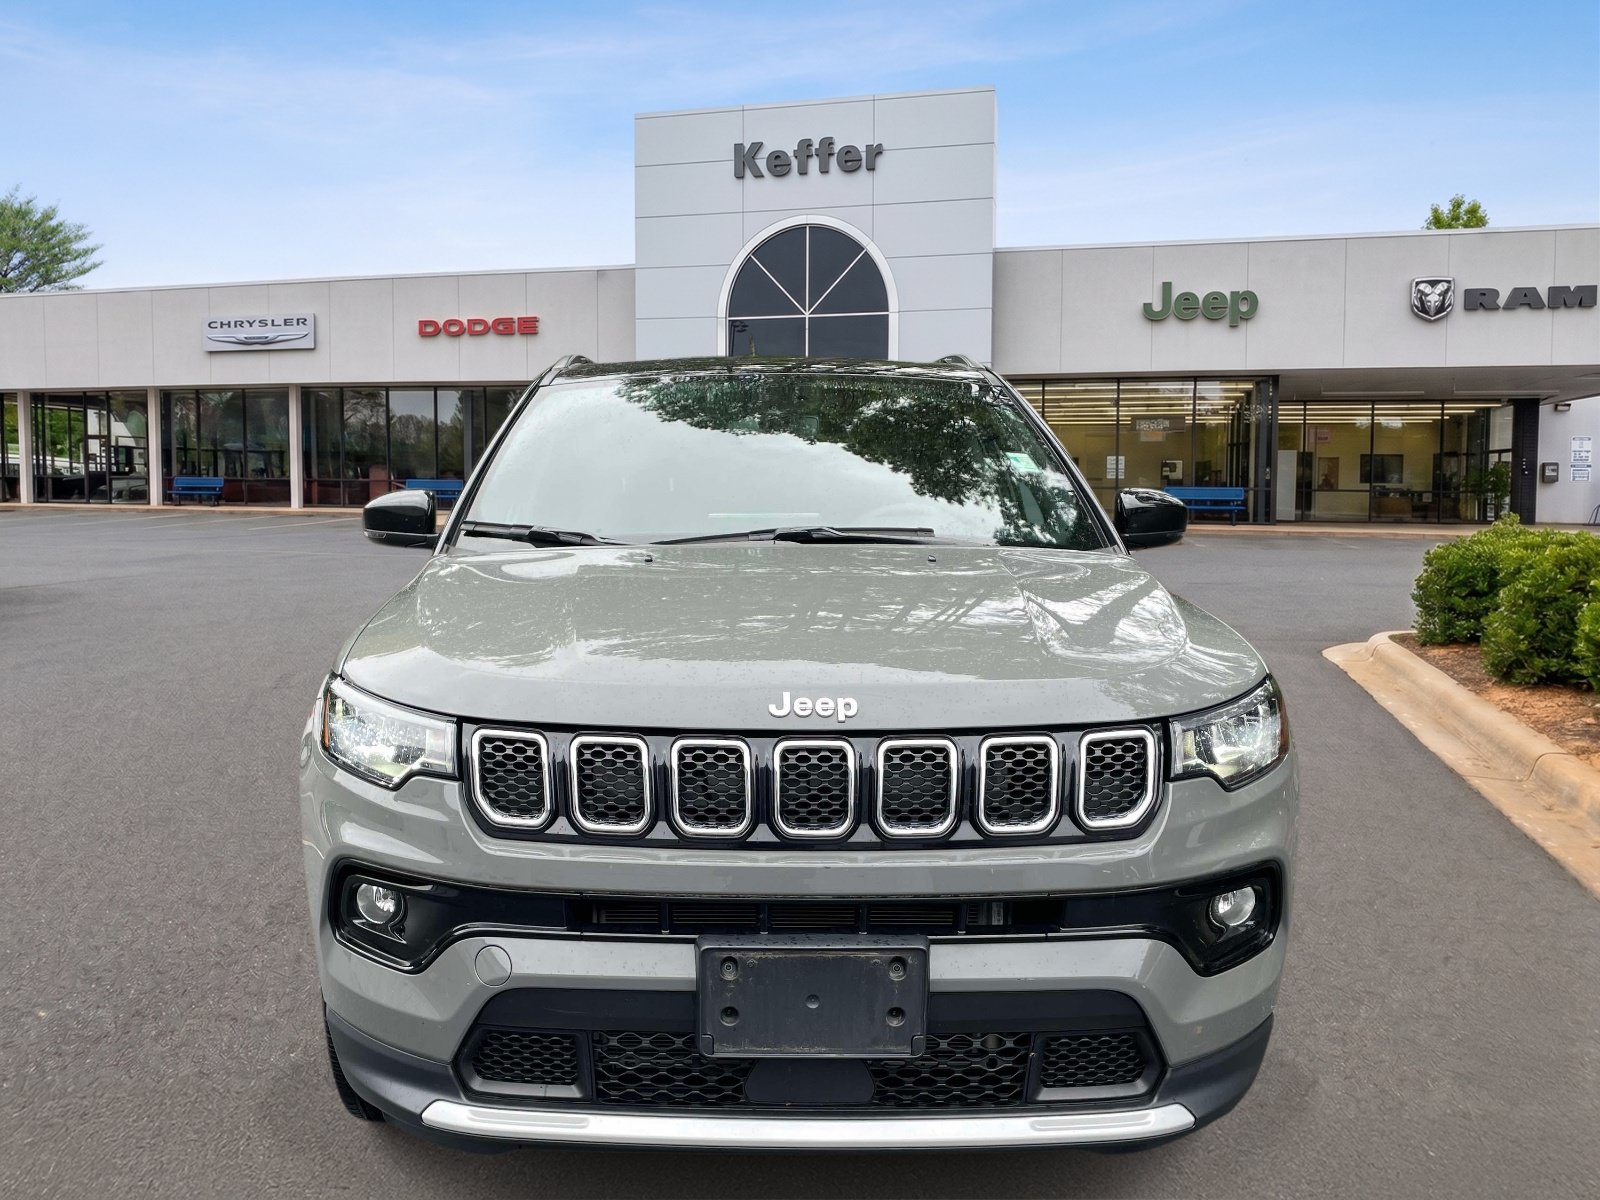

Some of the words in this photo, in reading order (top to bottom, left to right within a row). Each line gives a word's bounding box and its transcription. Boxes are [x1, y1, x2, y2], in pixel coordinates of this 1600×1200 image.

[733, 136, 884, 179] Keffer
[1142, 281, 1259, 328] Jeep
[1464, 285, 1598, 311] RAM
[207, 317, 308, 330] CHRYSLER
[418, 316, 539, 337] DODGE
[768, 691, 859, 723] Jeep
